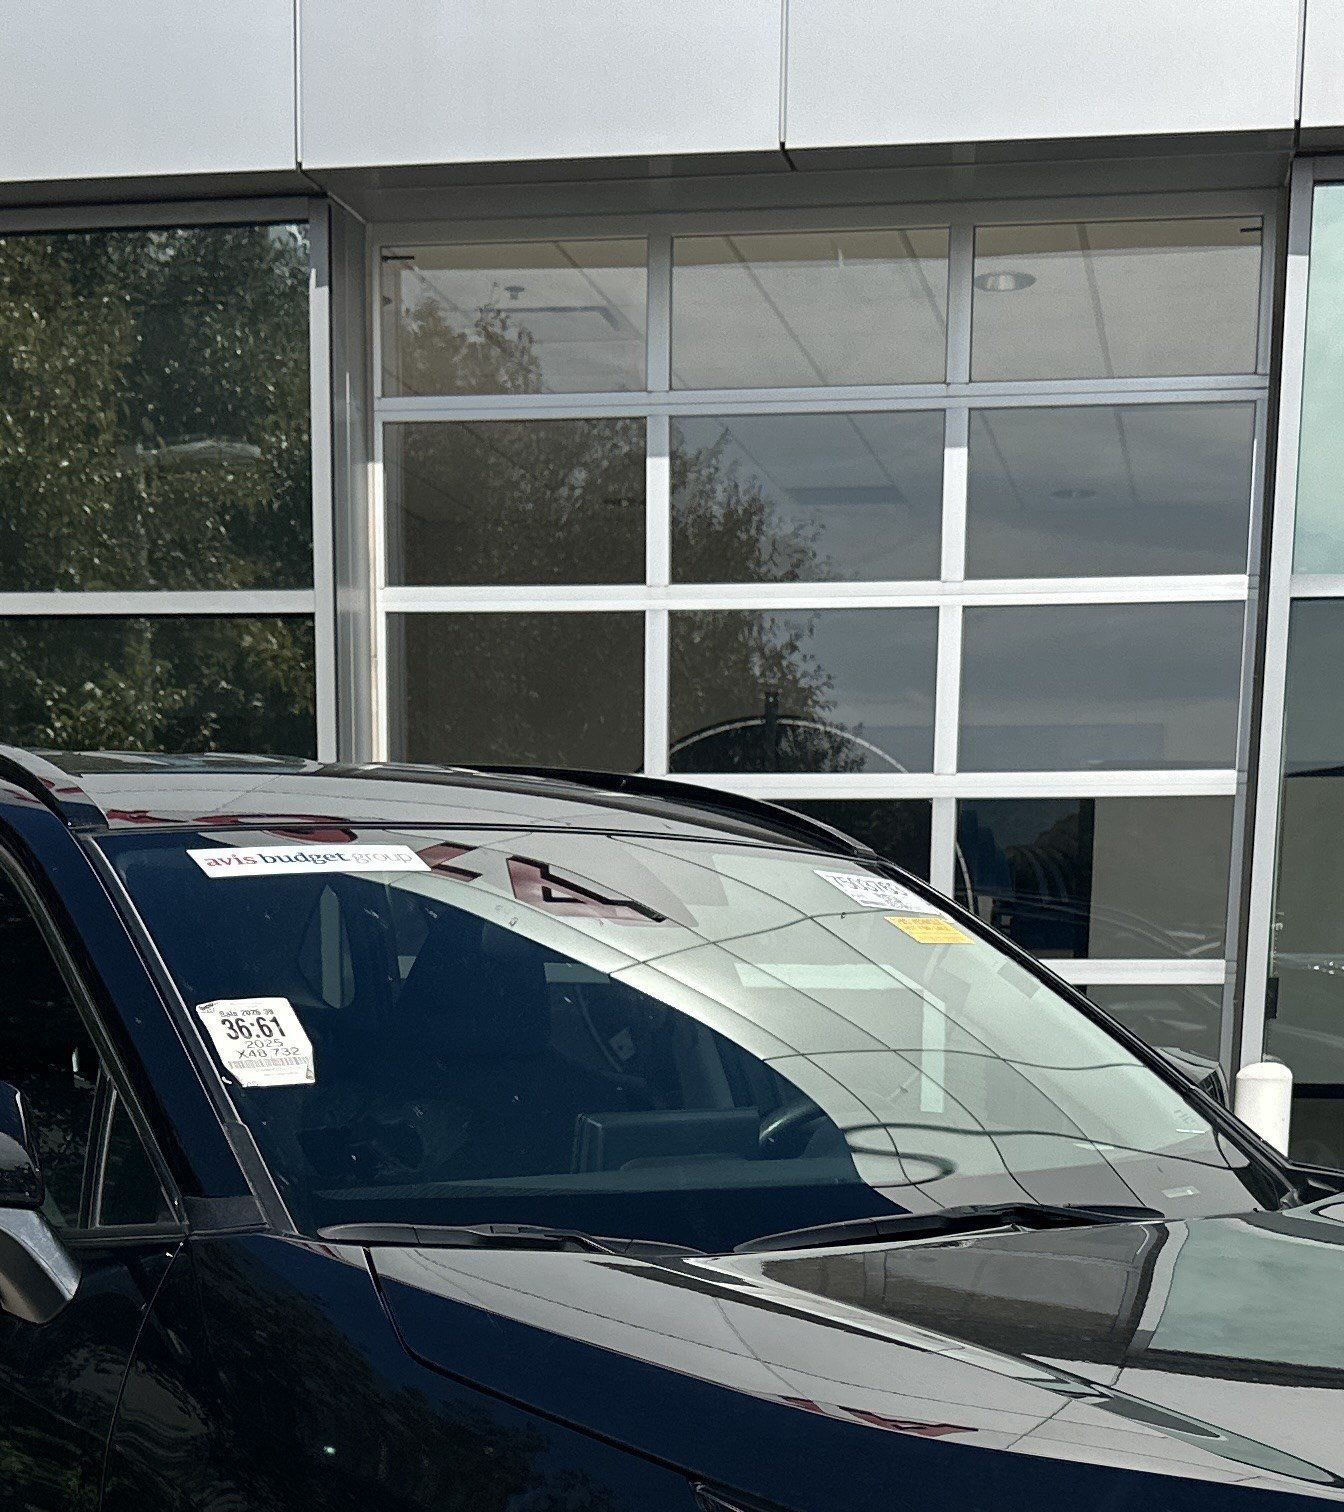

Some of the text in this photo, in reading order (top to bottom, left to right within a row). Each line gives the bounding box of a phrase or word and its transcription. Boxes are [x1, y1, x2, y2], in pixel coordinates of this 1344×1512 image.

[206, 851, 413, 867] avis budget group
[221, 1016, 286, 1040] 36:61
[246, 1039, 284, 1049] 2025
